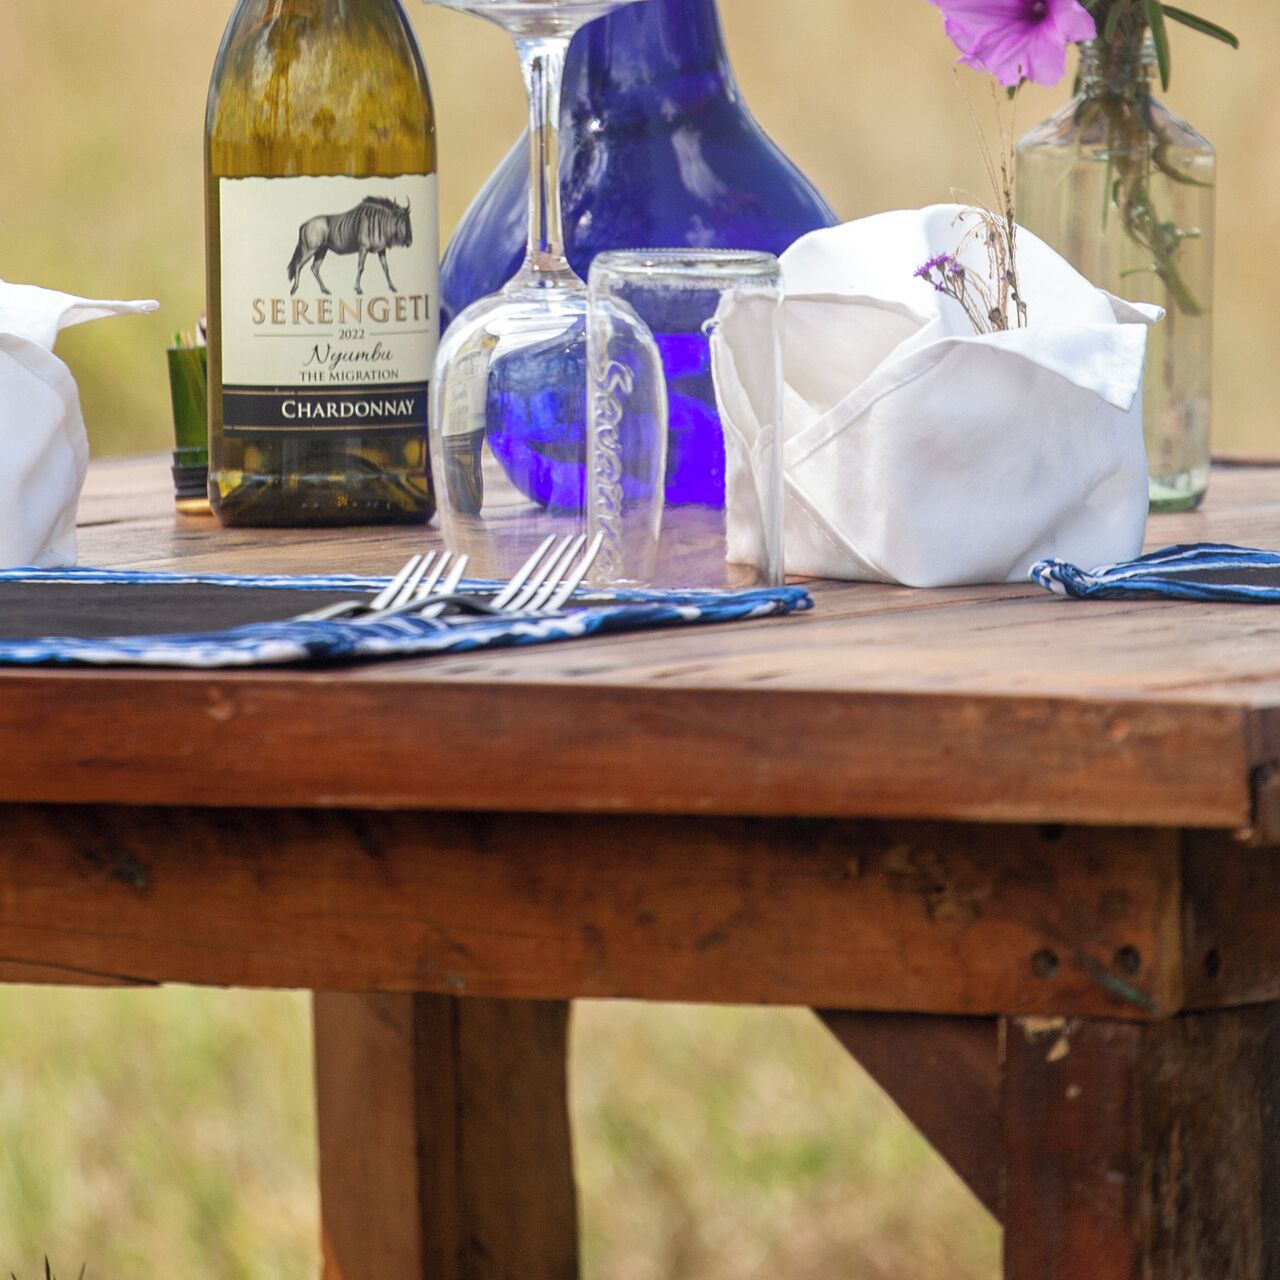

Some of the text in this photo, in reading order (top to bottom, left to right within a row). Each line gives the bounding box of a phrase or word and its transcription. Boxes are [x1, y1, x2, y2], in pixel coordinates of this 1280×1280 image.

[252, 295, 429, 325] SERENGETI
[338, 328, 365, 340] 2022
[303, 342, 394, 370] Nyumbu
[300, 369, 399, 382] THE MIGRATION
[281, 399, 415, 420] CHARDONNAY
